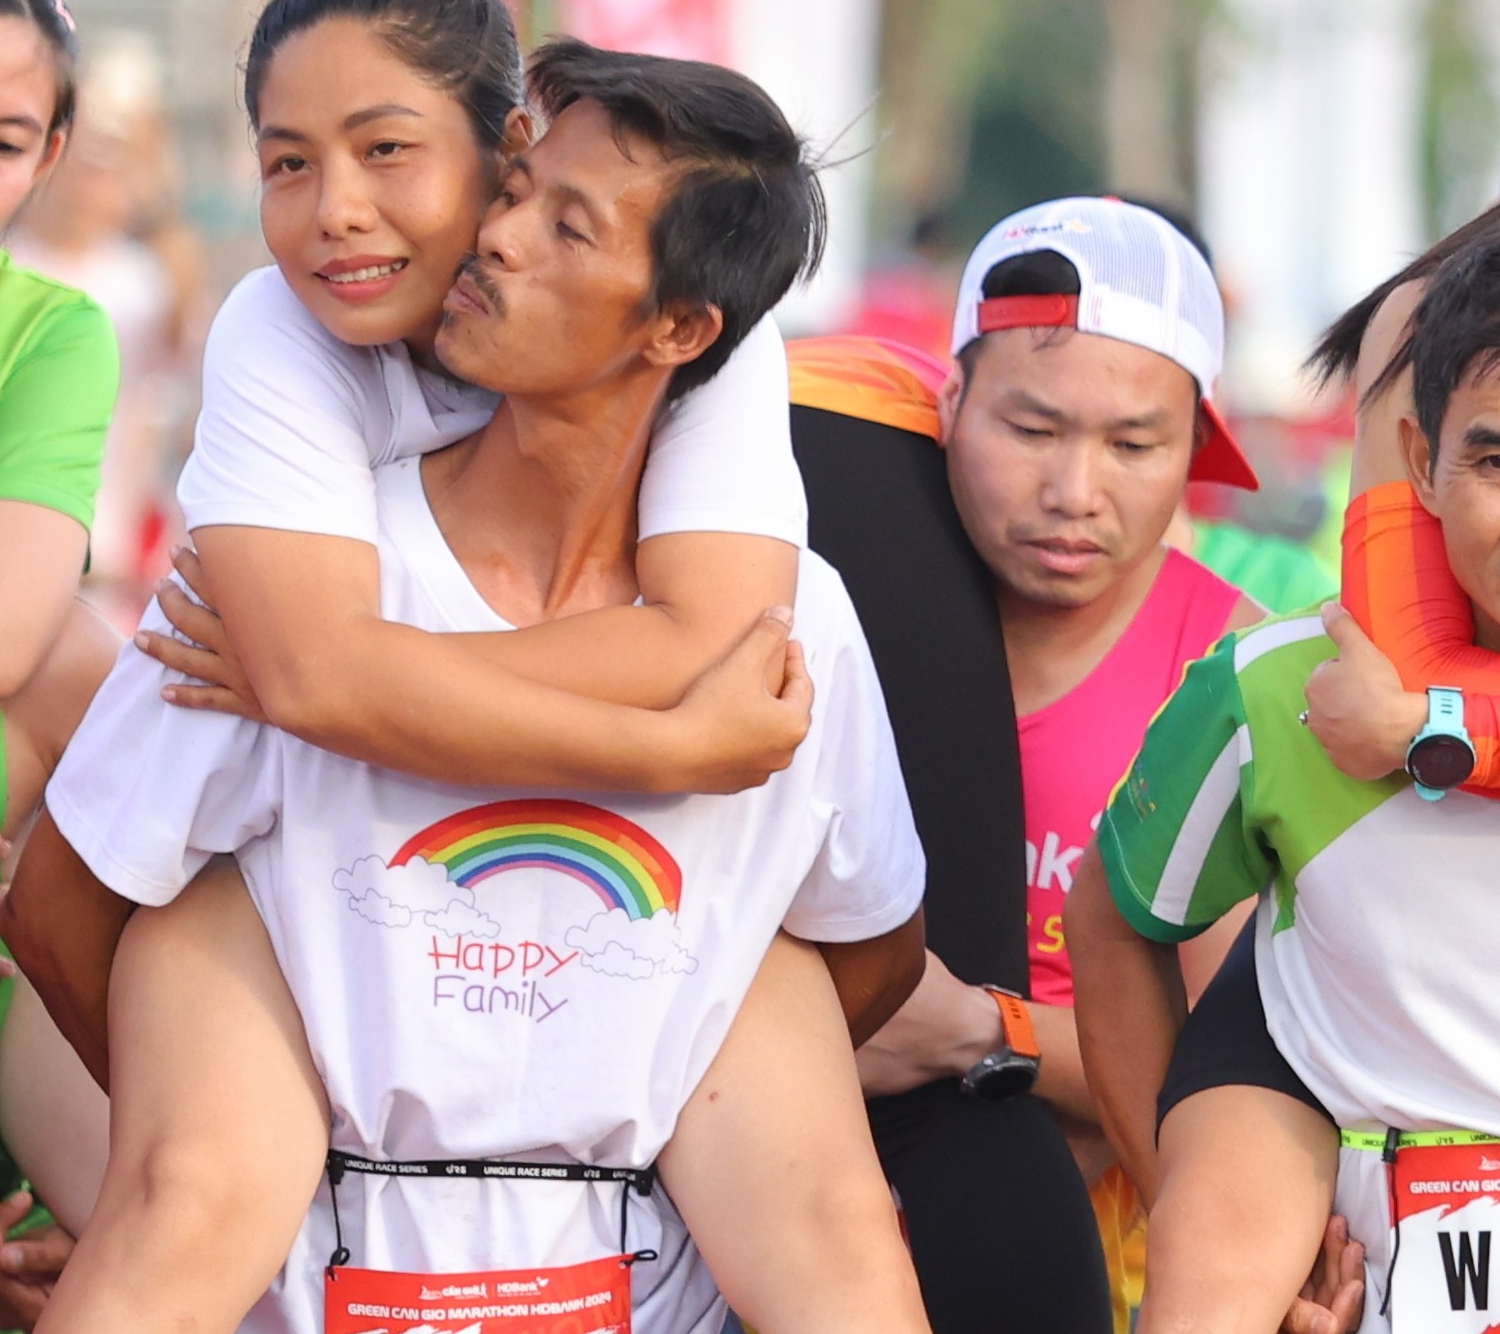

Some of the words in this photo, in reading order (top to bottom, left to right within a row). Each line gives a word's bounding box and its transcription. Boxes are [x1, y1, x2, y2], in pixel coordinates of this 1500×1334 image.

[428, 935, 579, 979] Happy
[434, 975, 568, 1023] Family
[345, 1159, 374, 1171] UNIQUE
[375, 1162, 397, 1172] RACE
[399, 1164, 428, 1174] SERIES
[484, 1167, 516, 1176] UNIQUE
[517, 1167, 540, 1177] RACE
[541, 1168, 567, 1178] SERIES
[1409, 1181, 1450, 1194] GREEN
[1453, 1180, 1480, 1193] CAN
[497, 1282, 537, 1294] HDBank
[347, 1303, 390, 1317] GREEN
[392, 1306, 420, 1319] CAN
[421, 1307, 445, 1320] GIO
[447, 1305, 526, 1319] MARATHON
[585, 1291, 612, 1308] 2024
